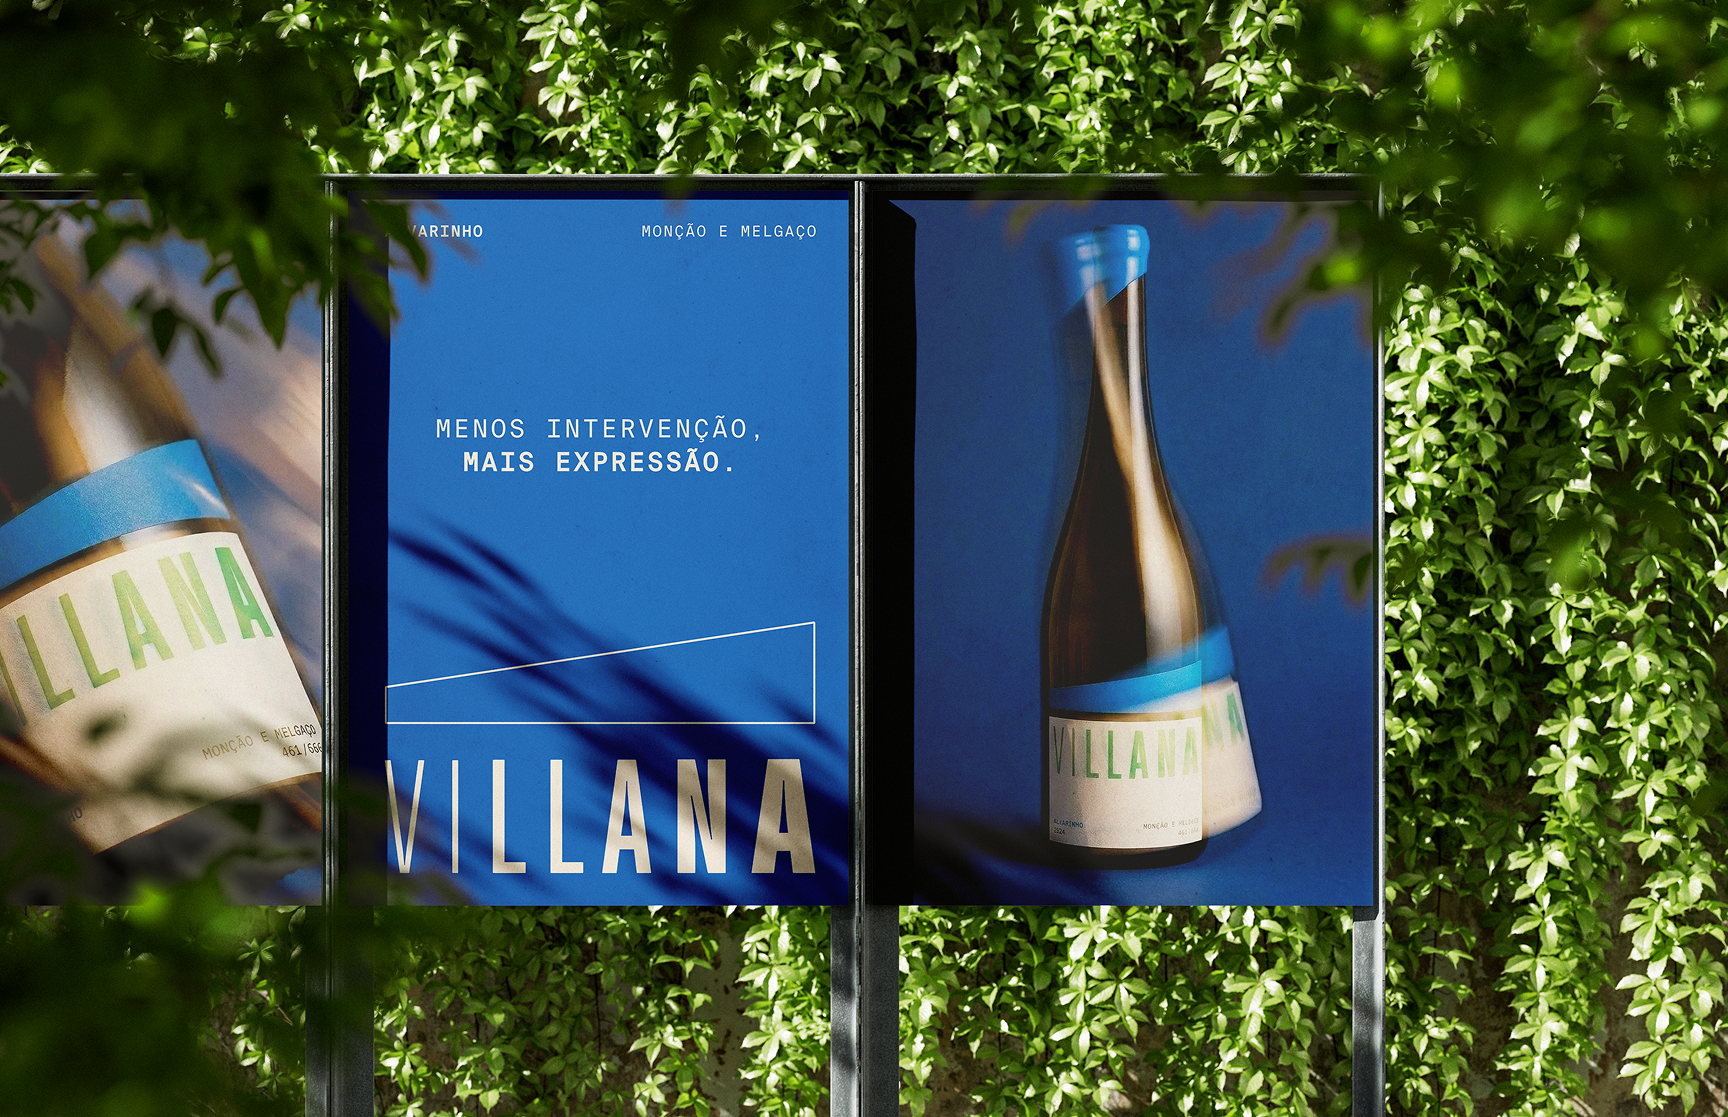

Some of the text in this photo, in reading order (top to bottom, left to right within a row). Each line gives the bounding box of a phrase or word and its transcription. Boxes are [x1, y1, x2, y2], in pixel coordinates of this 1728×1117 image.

[385, 225, 483, 238] VARINHO
[641, 222, 817, 241] MONÇÃO E MELGAÇO
[436, 414, 760, 443] MENOS INTERVENÇÃO,
[463, 447, 733, 473] MAIS EXPRESSÃO.
[202, 724, 317, 760] MONÇÃO E MELGAÇO
[1053, 725, 1199, 779] VILLANA
[385, 759, 816, 874] VILLANA
